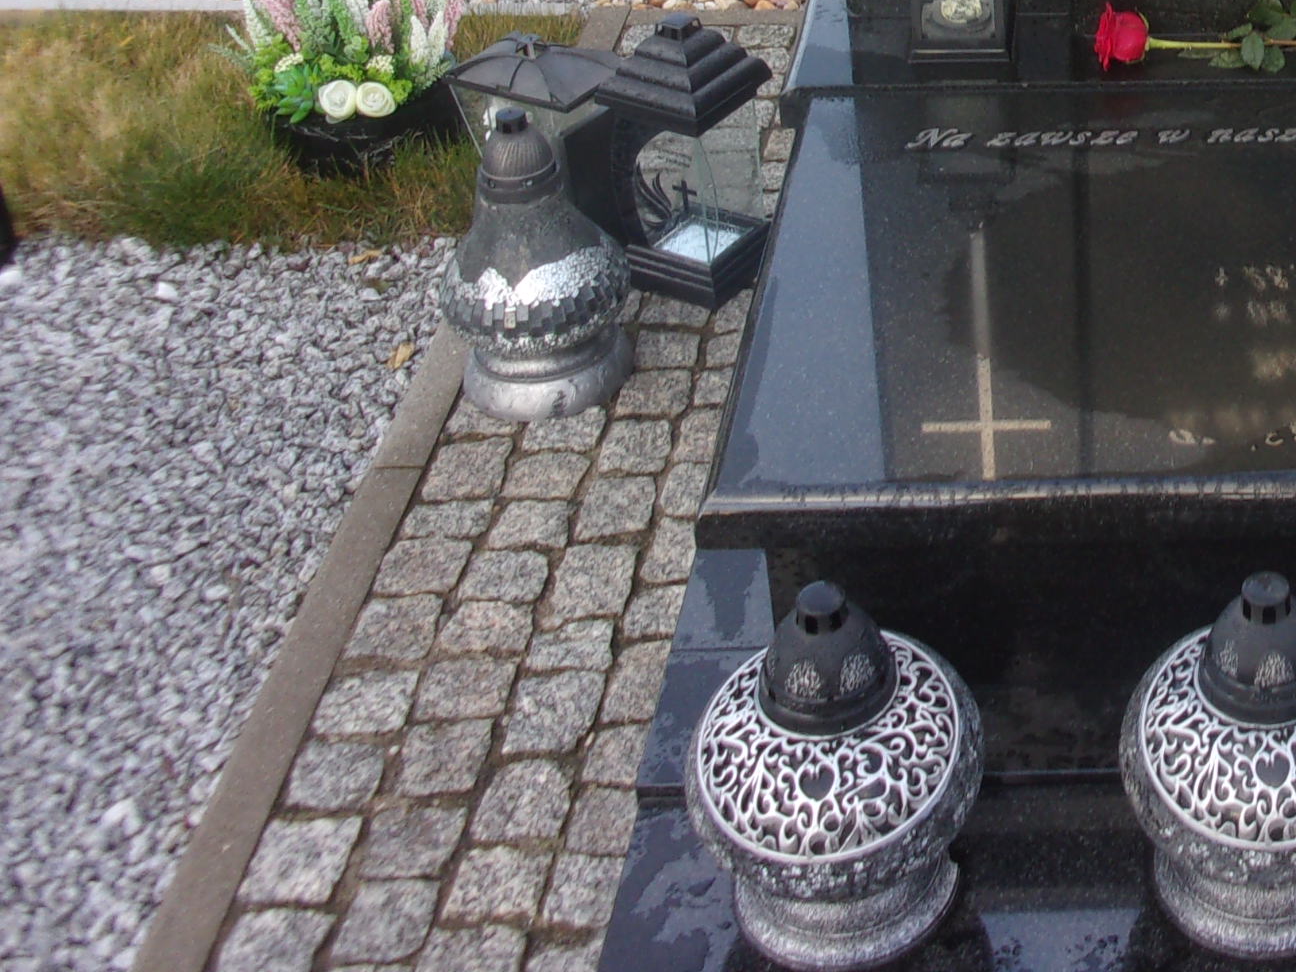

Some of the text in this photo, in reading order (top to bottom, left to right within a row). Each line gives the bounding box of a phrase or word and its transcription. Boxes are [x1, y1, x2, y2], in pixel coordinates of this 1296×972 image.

[904, 127, 972, 149] Na
[986, 129, 1138, 147] zawsze
[1156, 129, 1190, 145] w
